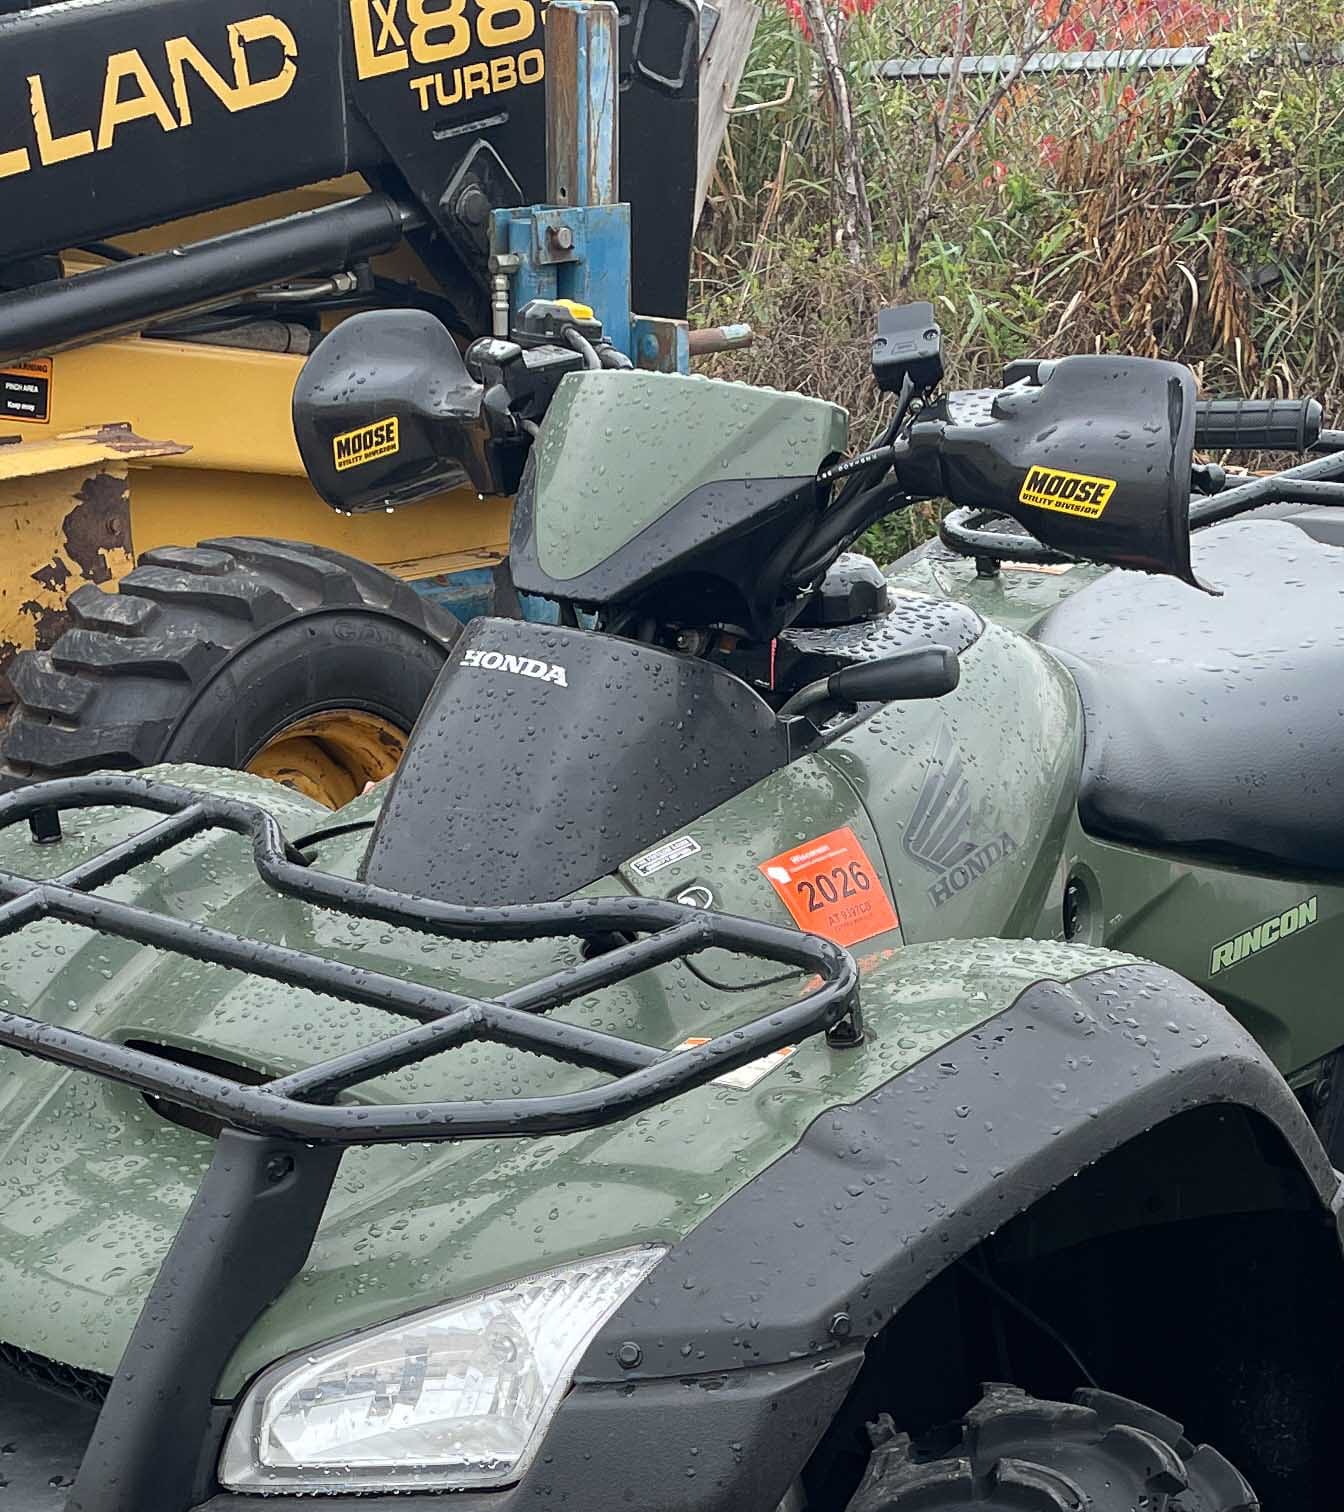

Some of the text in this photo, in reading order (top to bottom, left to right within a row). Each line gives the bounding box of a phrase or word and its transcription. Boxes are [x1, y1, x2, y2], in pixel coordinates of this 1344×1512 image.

[350, 0, 544, 80] LX88
[409, 48, 545, 111] TURBO
[5, 382, 39, 393] PINCH AREA
[337, 422, 395, 459] MOOSE
[338, 443, 397, 468] UTILITY DIVISION
[1022, 492, 1099, 516] UTILITY DIVISION
[1025, 470, 1109, 505] MOOSE
[459, 650, 569, 688] HONDA
[797, 861, 870, 912] 2026
[928, 831, 1017, 908] HONDA
[1210, 895, 1318, 976] RINCON
